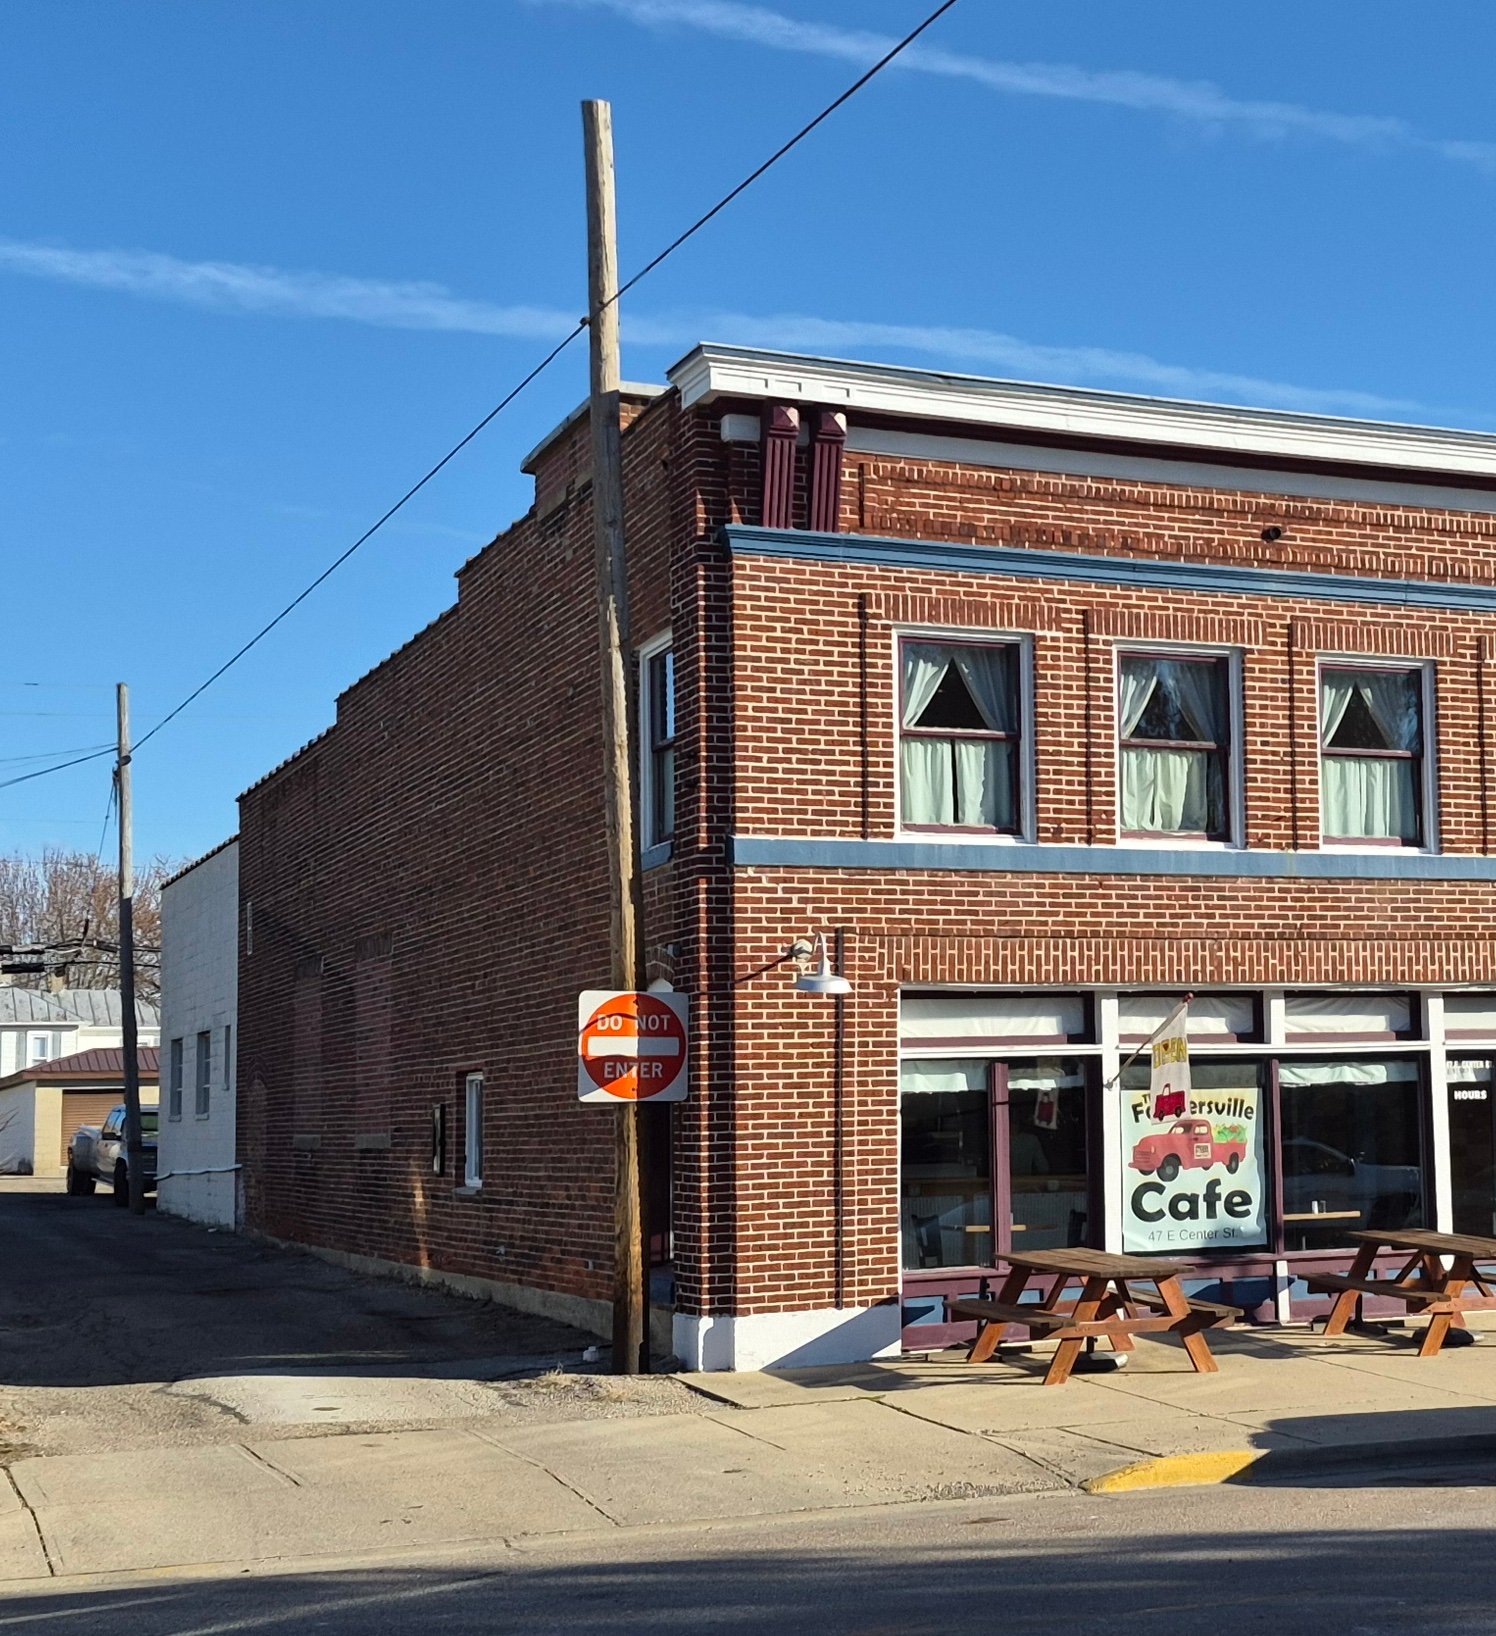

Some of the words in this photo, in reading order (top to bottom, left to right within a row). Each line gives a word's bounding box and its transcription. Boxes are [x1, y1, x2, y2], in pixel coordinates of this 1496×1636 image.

[597, 1015, 623, 1030] DO
[636, 1015, 670, 1031] NOT
[604, 1062, 662, 1078] ENTER
[1453, 1090, 1487, 1100] HOURS
[1132, 1098, 1254, 1123] Fersville
[1131, 1178, 1253, 1222] Cafe
[1148, 1231, 1163, 1241] 47
[1167, 1230, 1175, 1240] E
[1179, 1229, 1219, 1240] Center
[1222, 1227, 1239, 1239] St.
